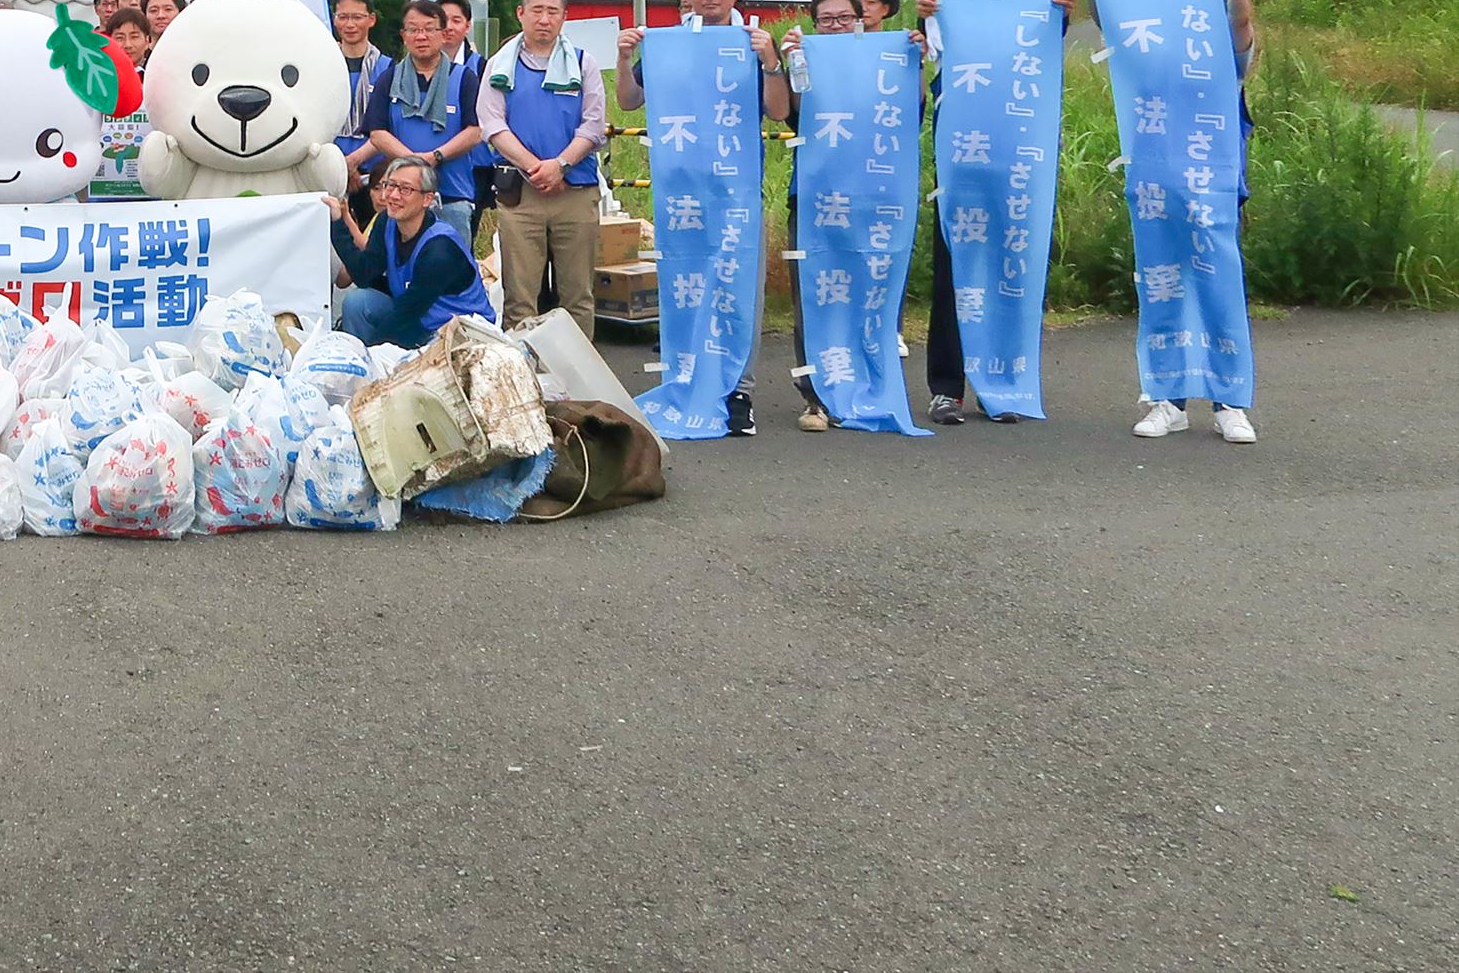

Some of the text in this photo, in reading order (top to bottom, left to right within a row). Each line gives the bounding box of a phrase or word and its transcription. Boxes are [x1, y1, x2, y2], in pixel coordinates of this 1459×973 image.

[813, 112, 856, 387] 不法投棄
[951, 62, 993, 324] 不法投棄
[1120, 17, 1185, 304] 不法投棄
